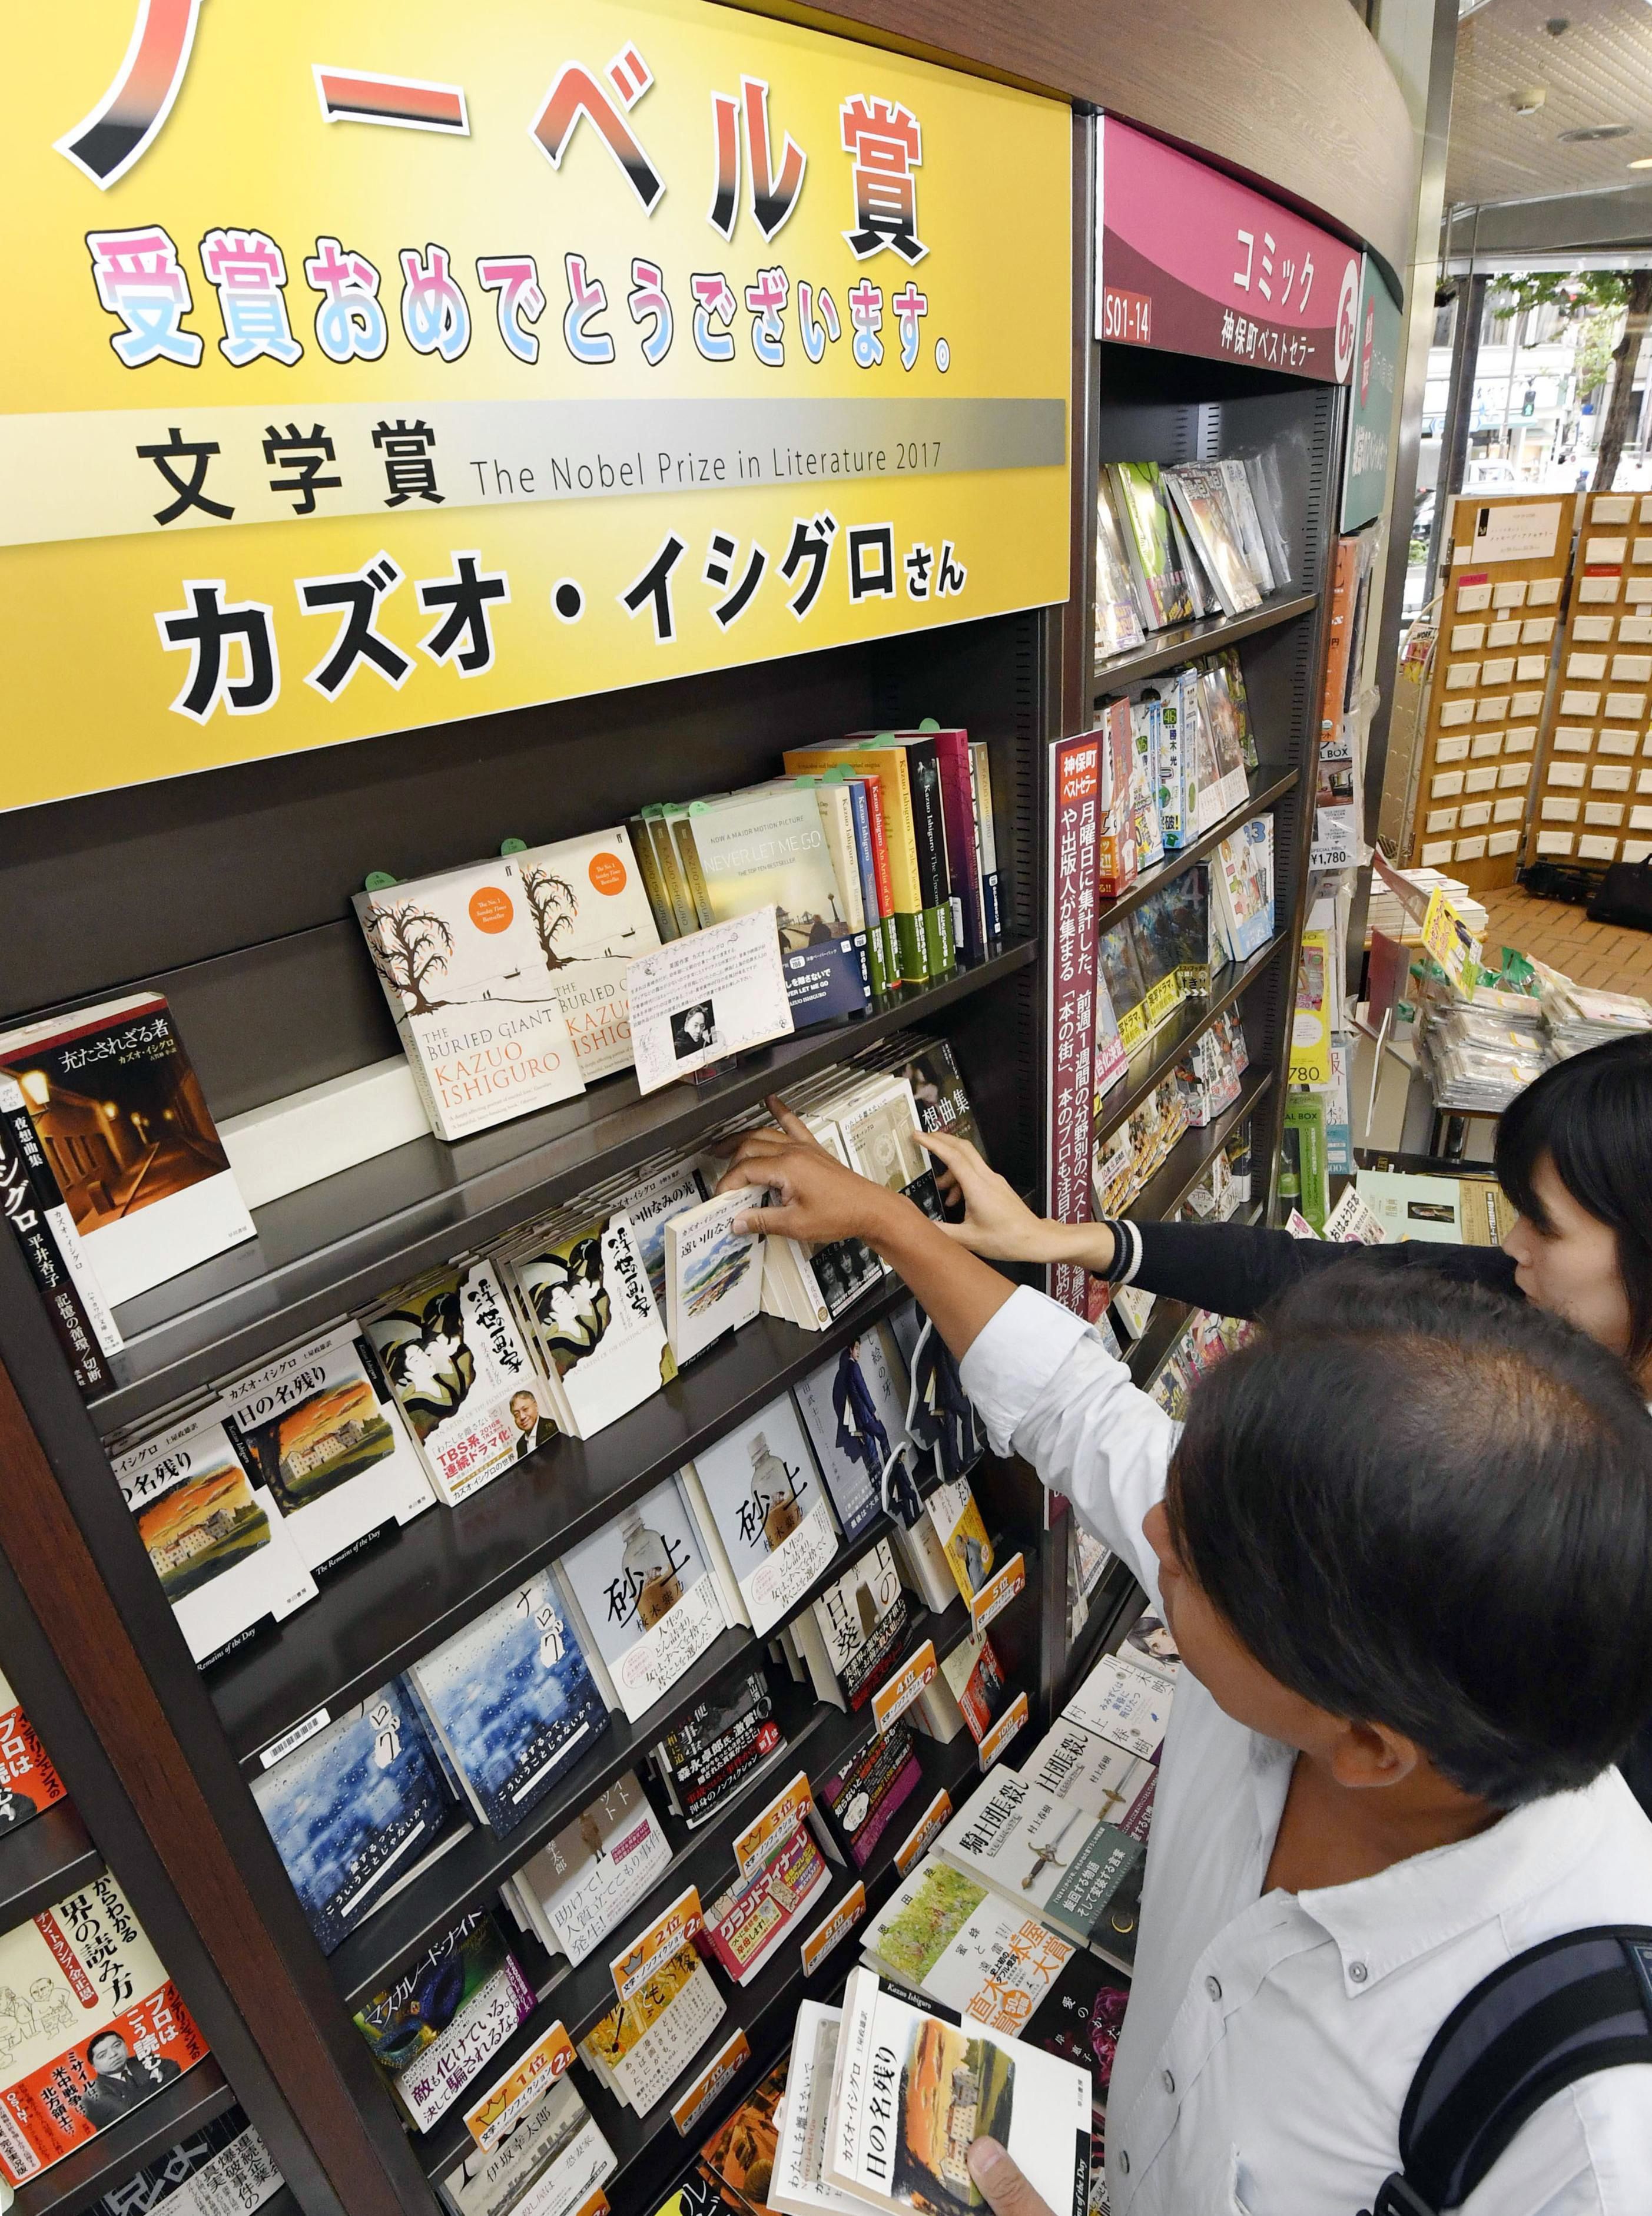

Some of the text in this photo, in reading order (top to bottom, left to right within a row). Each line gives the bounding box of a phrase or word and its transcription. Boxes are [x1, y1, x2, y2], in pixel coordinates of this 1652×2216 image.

[54, 0, 930, 266] ノーベル賞
[1233, 229, 1315, 314] コミック
[85, 224, 950, 373] 受賞おめでとうございます。
[1106, 294, 1149, 340] S01-14
[1220, 309, 1315, 366] 神保町ベストセラー
[135, 419, 446, 526] 文学賞
[470, 441, 943, 496] The Nobel Prize in Literature 2017
[154, 509, 966, 726] カズオ・イシグロさん
[1063, 750, 1097, 778] 神保町
[1063, 776, 1097, 799] ベストセラー
[871, 785, 883, 847] Kazuo Ishiguro
[899, 759, 911, 832] Kazuo Ishiguro
[924, 784, 935, 852] Kazuo Ishiguro
[704, 830, 822, 874] NEVER LET ME GO
[711, 815, 804, 844] NOW MAJOR MOTION PICTURE
[845, 828, 854, 866] Ishiguro
[858, 795, 870, 862] Kazuo Ishiguro
[767, 857, 796, 870] BESTSELLER
[1311, 850, 1347, 865] ¥1,780
[670, 882, 688, 926] ISHIGURO
[555, 982, 578, 997] THE
[559, 985, 614, 1013] BURIED
[58, 1018, 169, 1074] 充たされざる者
[118, 1039, 175, 1066] カズオ・イシグロ
[423, 1028, 449, 1042] THE
[428, 1009, 553, 1061] BURIED GIANT
[434, 1042, 523, 1086] KAZUO
[441, 1052, 560, 1108] ISHIGURO
[844, 1098, 889, 1131] わたしを離さないで
[1297, 1112, 1318, 1120] BOX
[14, 1117, 44, 1168] 夜想曲集
[54, 1210, 82, 1271] カズオ・イシグロ
[682, 1206, 728, 1237] カズオ・イシグロ
[28, 1235, 60, 1288] 平井杏子
[607, 1227, 652, 1320] 浮世の画家
[467, 1278, 523, 1374] 浮世の画家
[229, 1357, 297, 1400] カズオ・イシグロ
[237, 1366, 327, 1426] 日の名残り
[437, 1433, 480, 1467] TBS系
[444, 1427, 514, 1480] 連続ドラマ化!
[453, 1453, 516, 1500] カズオ・イシグロの世界
[735, 1462, 808, 1548] 砂上
[763, 1506, 804, 1552] 桜木紫乃
[328, 1551, 353, 1571] Remains
[771, 1536, 827, 1603] 女は、すべてを捨てて
[779, 1540, 815, 1576] どん詰まり。
[782, 1532, 804, 1558] 人生の
[603, 1534, 691, 1629] 砂上
[636, 1580, 684, 1632] 桜木紫乃
[781, 1554, 828, 1609] 書くことを選んだ。
[992, 1578, 1009, 1598] 5位
[646, 1614, 712, 1684] 女は、すべてを捨てて
[655, 1620, 695, 1658] どん詰まり。
[659, 1609, 683, 1639] 人生の
[197, 1650, 224, 1671] Remains
[658, 1634, 712, 1691] 書くことを選んだ。
[896, 1670, 915, 1695] 4位
[882, 1672, 924, 1725] 文学・ノンフィクション
[497, 1701, 592, 1801] こういうことじゃないか?
[519, 1720, 566, 1765] 愛するって、
[677, 1710, 758, 1781] 森永卓郎氏、激賞!
[999, 1715, 1014, 1739] 10位
[1066, 1704, 1154, 1756] 村上春樹
[697, 1728, 761, 1786] 隠された真実がここに!
[1089, 1754, 1112, 1784] 村上春樹
[689, 1754, 758, 1816] 渾身のノンフィクション
[771, 1799, 795, 1827] 3位
[796, 1800, 811, 1822] 2F
[959, 1777, 1029, 1856] 騎士団長殺し
[1026, 1804, 1054, 1836] 村上春樹
[326, 1797, 427, 1916] こういうことじゃないか?
[351, 1821, 400, 1875] 愛するって、
[744, 1811, 797, 1869] 文学・ノンフィクション
[92, 1877, 138, 1943] からわかる
[554, 1871, 603, 1928] 助けて!
[566, 1829, 661, 1940] 人質立てこもり事件
[720, 1830, 810, 1940] グランドフィナーレ
[877, 1867, 936, 1936] 恩田陸
[1061, 1861, 1101, 1913] 旋回する物語
[572, 1916, 607, 1957] 発生!
[655, 1914, 683, 1947] 2位
[685, 1919, 701, 1940] 2F
[824, 1916, 845, 1939] 8位
[364, 1909, 483, 2026] マスカレード・ナイト
[622, 1925, 685, 1994] 文学・ノンフィクション
[989, 1951, 1010, 1977] 史上初の
[994, 1953, 1020, 1985] ダブル受賞
[145, 1989, 180, 2046] プロは
[887, 1983, 932, 2009] Kazuo Ishiguro
[127, 2009, 163, 2083] こう読む!
[167, 1986, 200, 2061] インテリジェンスの
[652, 2029, 671, 2053] ときも、
[662, 2018, 678, 2042] どんな
[855, 2011, 868, 2054] 土屋政雄訳
[411, 1998, 510, 2108] 敵も化けている。
[422, 2015, 520, 2123] 決して騙されるな。
[516, 2052, 548, 2086] 1位
[553, 2049, 572, 2073] 2F
[625, 2062, 645, 2086] あった。
[633, 2051, 651, 2076] そばに
[642, 2038, 660, 2067] 漫画が
[480, 2065, 552, 2141] 文学・ノンフィクション
[701, 2065, 725, 2092] 7位
[5, 2093, 29, 2124] OSINT
[788, 2062, 815, 2188] わたしを離さないで
[843, 2062, 862, 2164] カズオ・イシグロ
[865, 2046, 898, 2179] 日の名残り
[486, 2106, 552, 2181] 伊坂幸太郎
[1076, 2158, 1087, 2179] Day
[203, 2161, 227, 2197] 真実
